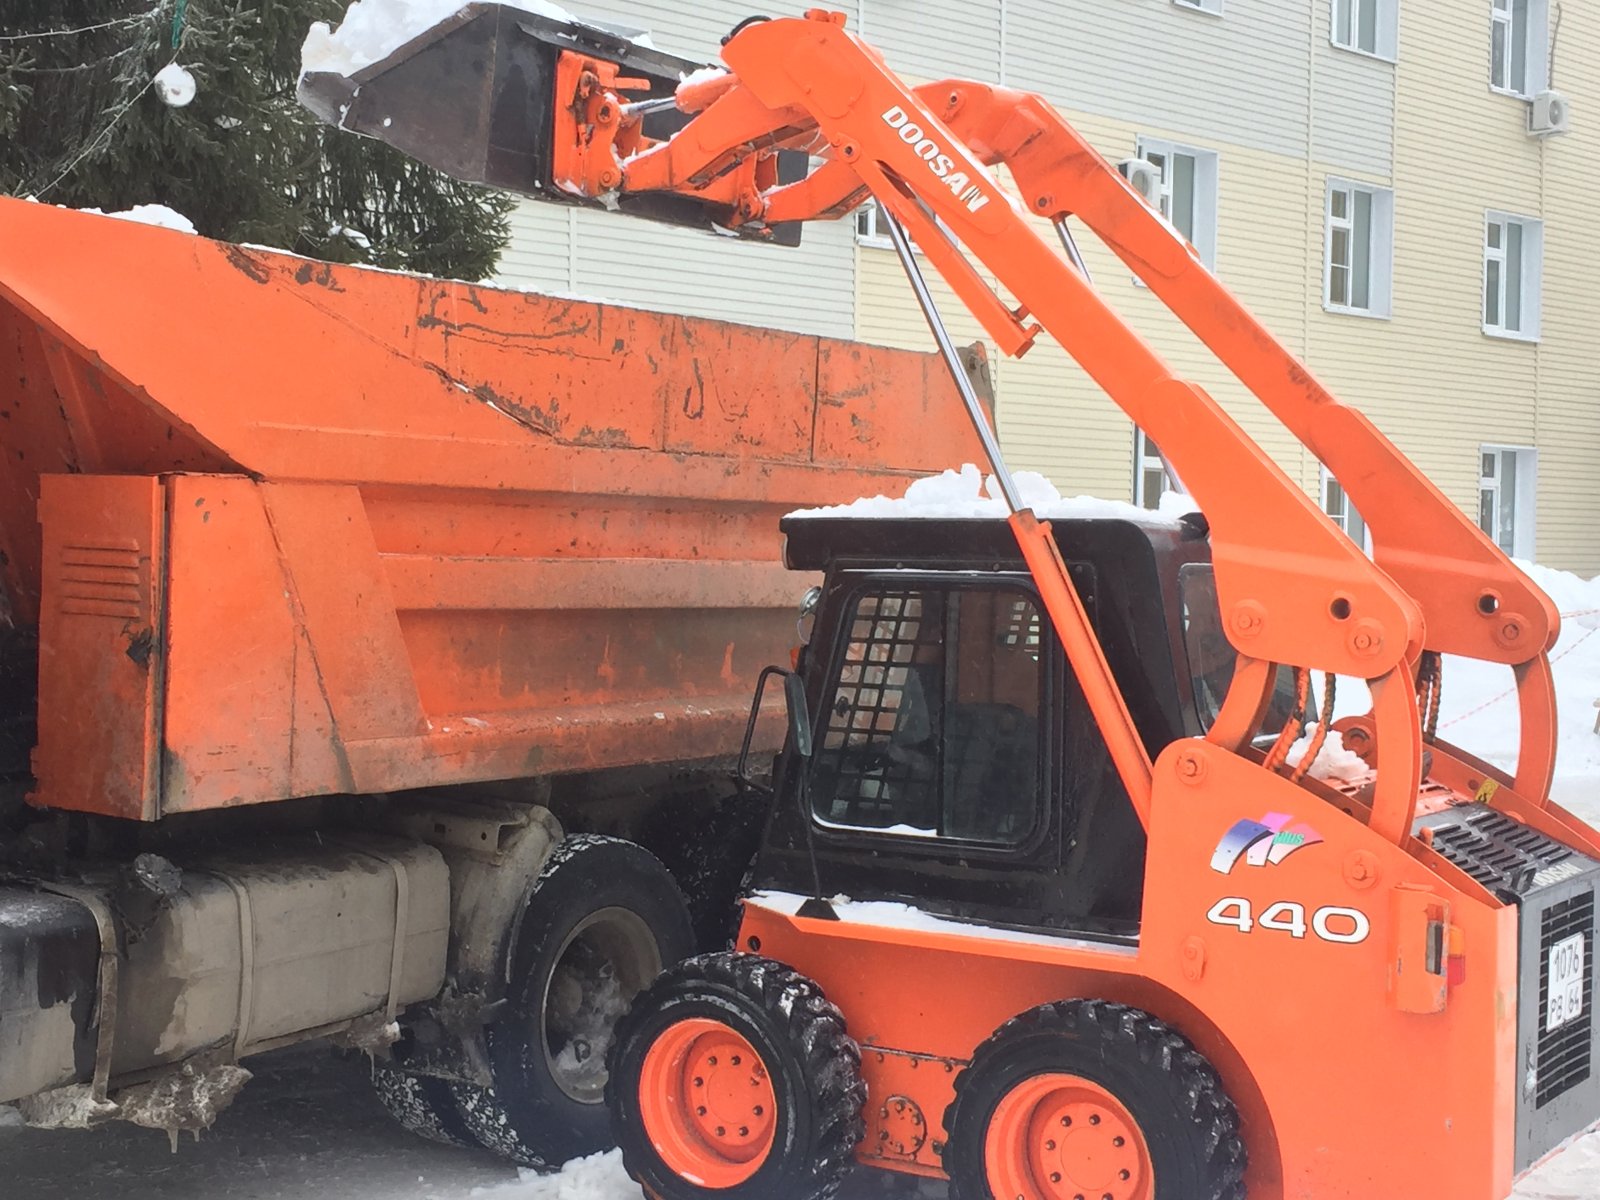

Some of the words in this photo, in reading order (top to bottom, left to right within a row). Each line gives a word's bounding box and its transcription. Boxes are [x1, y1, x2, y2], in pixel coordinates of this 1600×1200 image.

[881, 105, 990, 213] DOOSAN
[1206, 896, 1370, 944] 440
[1554, 942, 1579, 982] 1076
[1568, 986, 1579, 1013] 64
